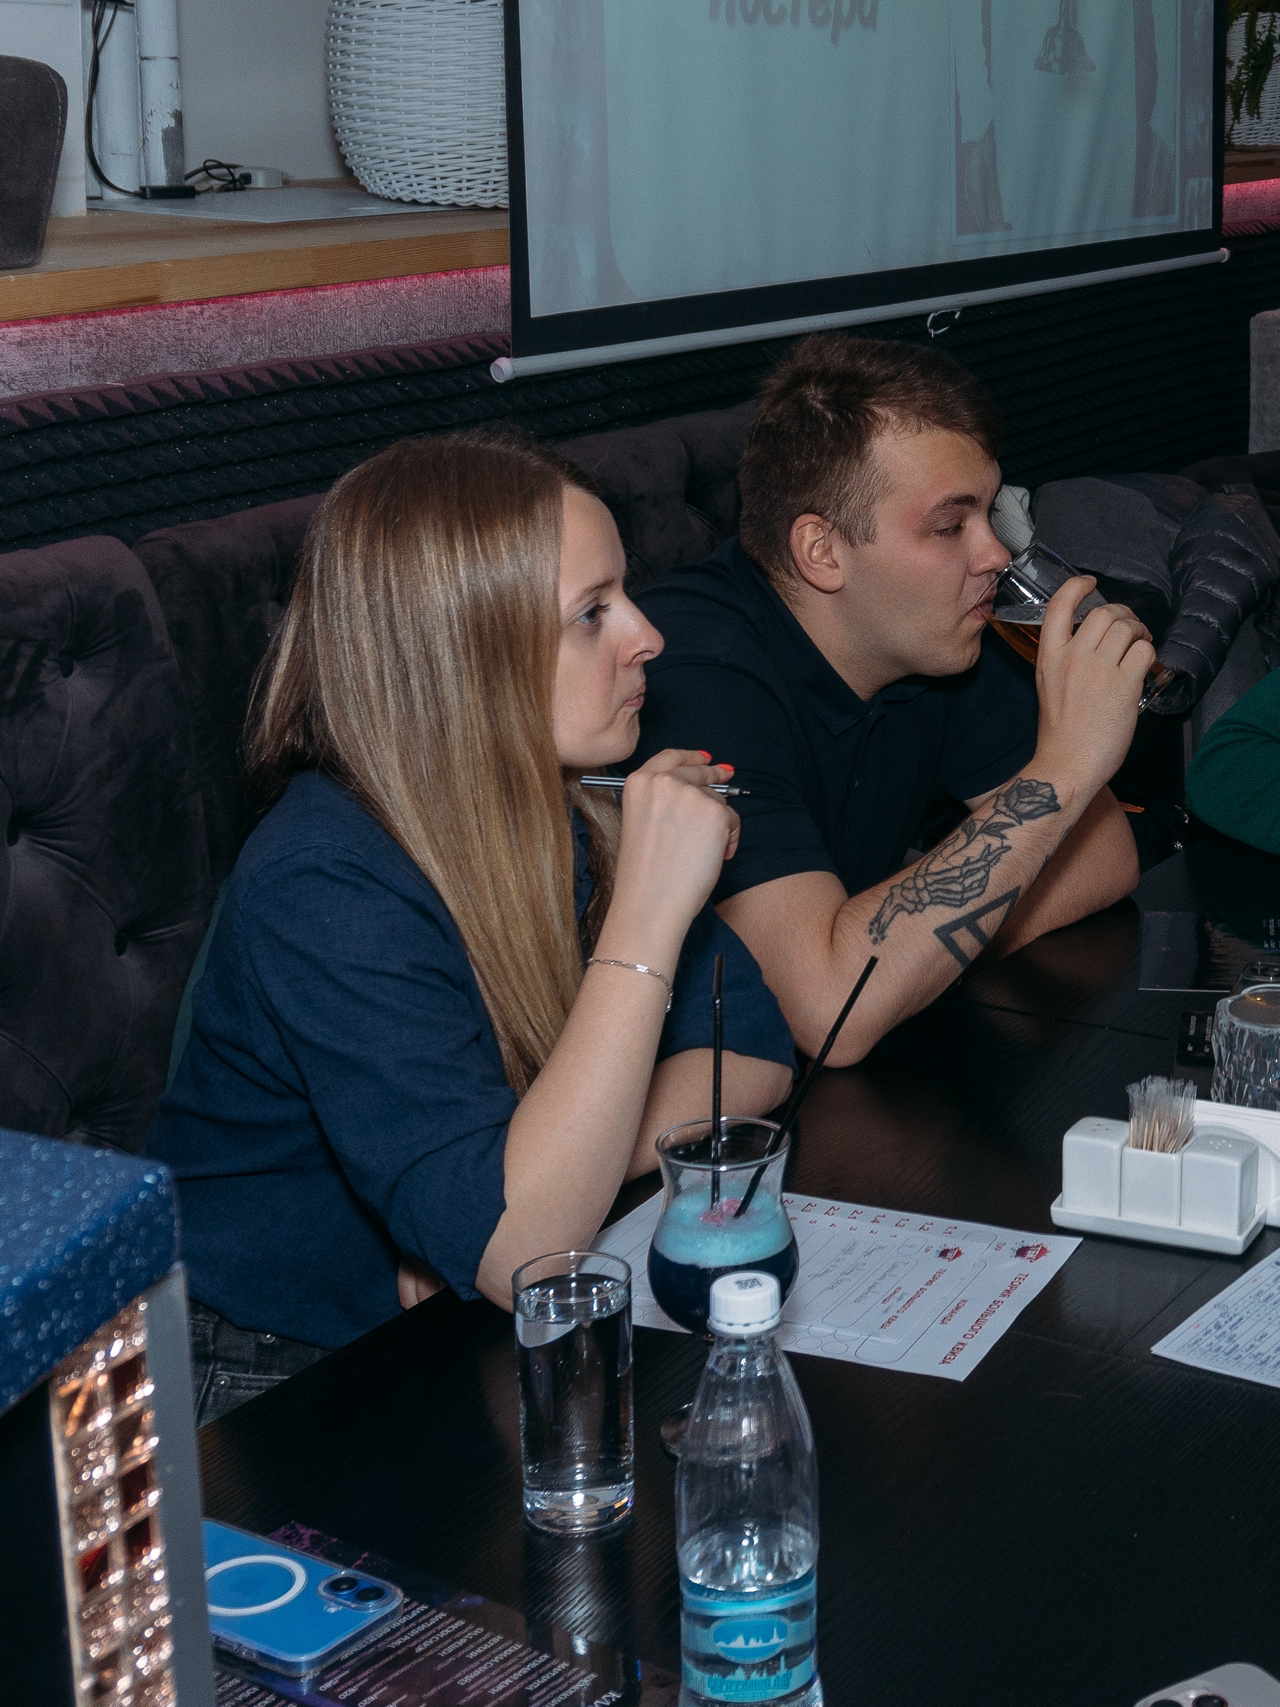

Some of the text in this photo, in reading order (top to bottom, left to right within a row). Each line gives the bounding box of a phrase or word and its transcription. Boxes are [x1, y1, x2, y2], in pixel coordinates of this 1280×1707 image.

[925, 1268, 947, 1287] ТЕОРИЯ
[938, 1272, 1030, 1365] ТЕОРИЯ БОЛЬШОГО КВИЗА
[939, 1298, 969, 1325] КОМАНДА
